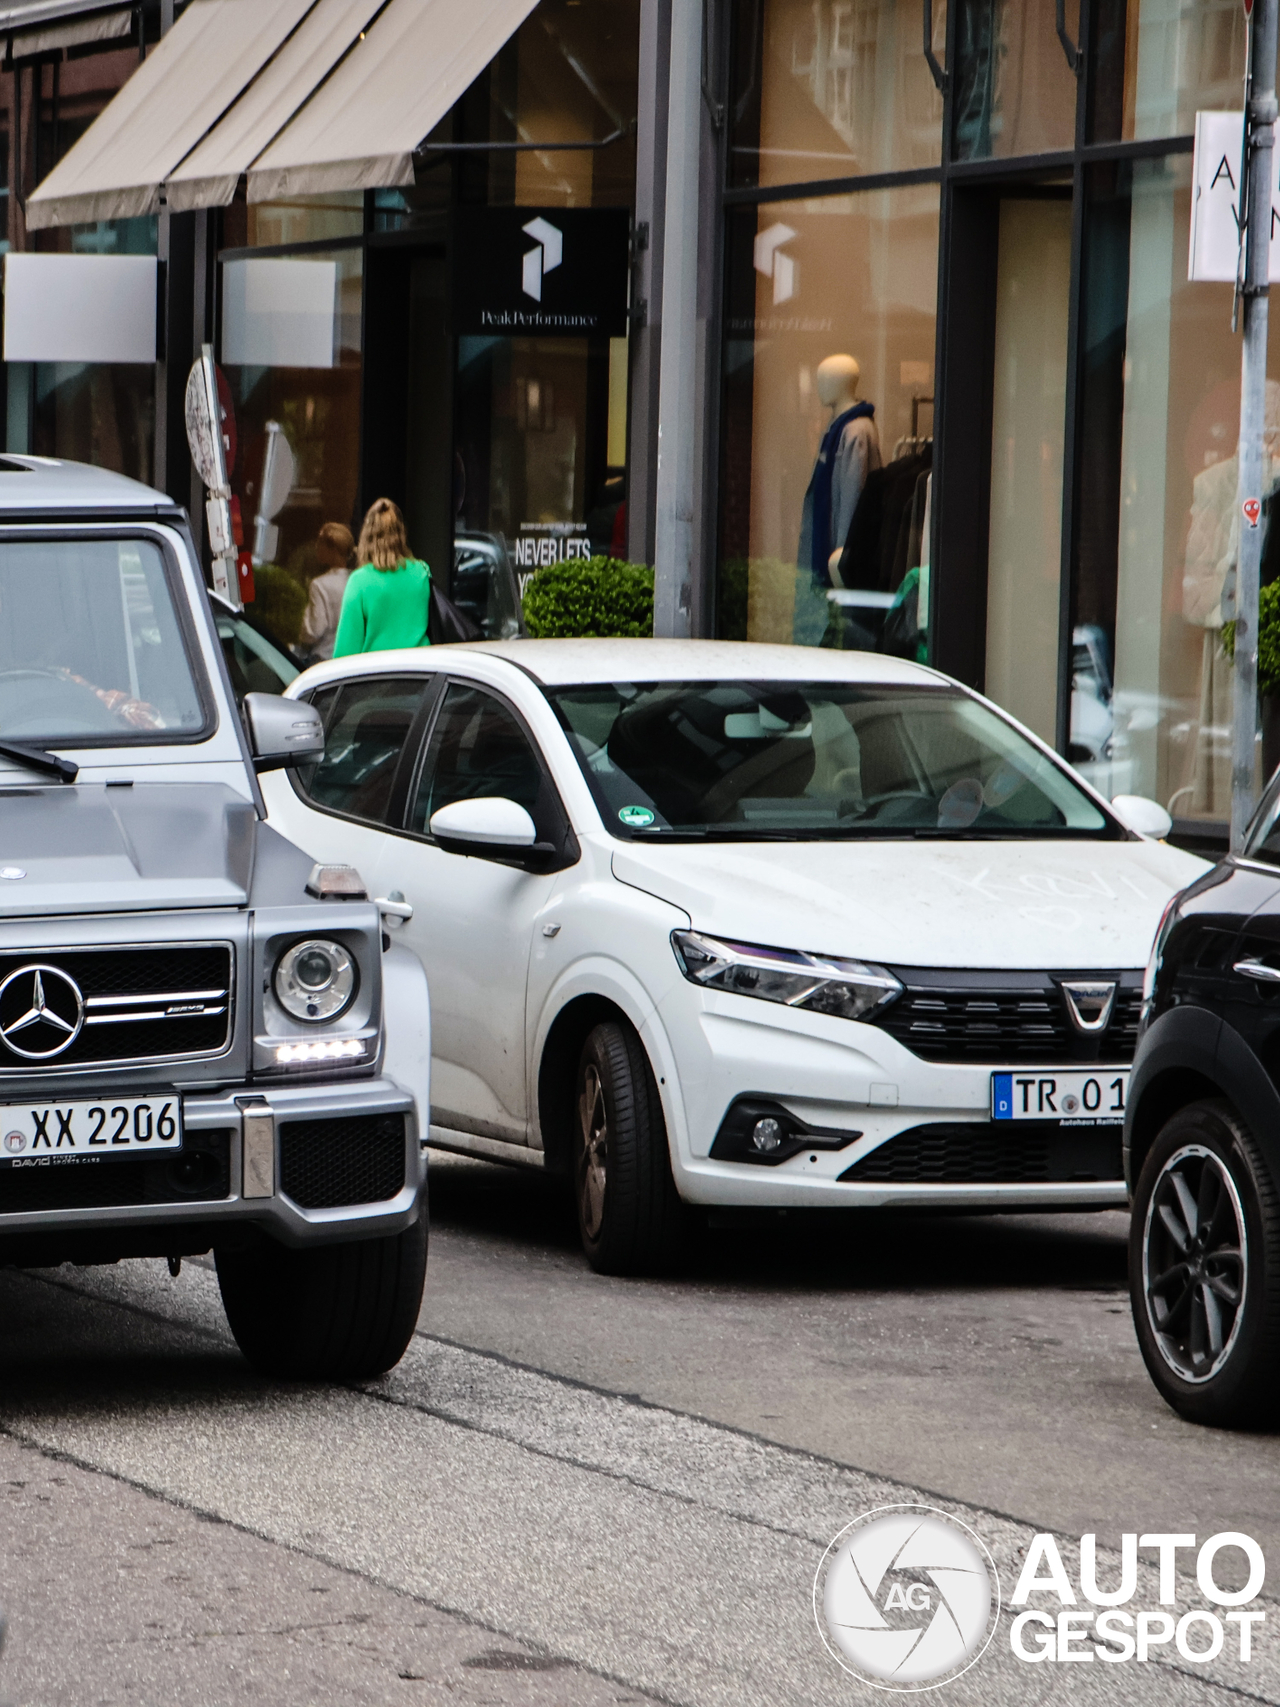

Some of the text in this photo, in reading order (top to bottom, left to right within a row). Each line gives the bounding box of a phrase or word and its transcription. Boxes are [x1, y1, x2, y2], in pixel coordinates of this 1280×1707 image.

[515, 538, 557, 566] NEVER
[999, 1100, 1008, 1112] D
[1015, 1079, 1058, 1113] TR
[30, 1108, 76, 1149] XX
[87, 1102, 177, 1146] 2206
